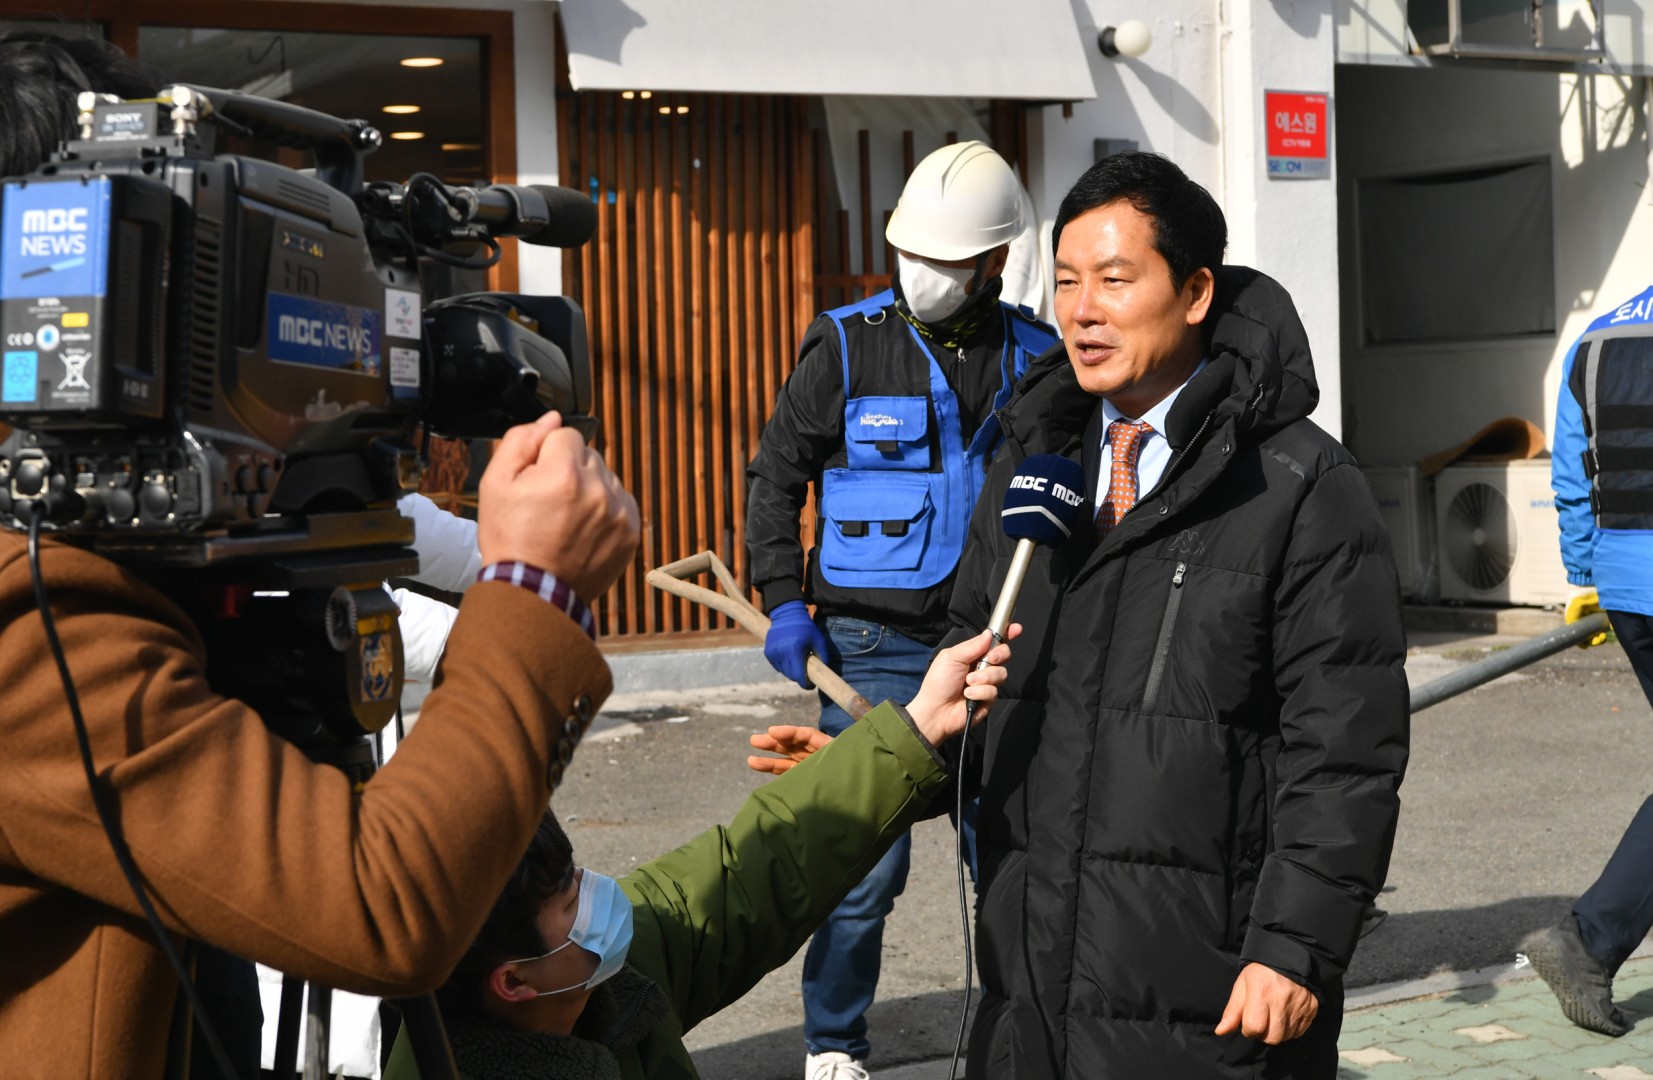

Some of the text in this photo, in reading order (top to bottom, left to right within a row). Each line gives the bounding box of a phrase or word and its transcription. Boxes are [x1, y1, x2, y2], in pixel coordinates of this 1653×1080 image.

[105, 112, 142, 124] SONY
[1275, 111, 1317, 135] 에스원
[22, 207, 89, 234] MBC
[21, 233, 87, 257] NEWS
[1610, 297, 1653, 324] 도시
[278, 314, 323, 347] MBC
[324, 322, 372, 354] NEWS
[1009, 475, 1049, 492] MBC
